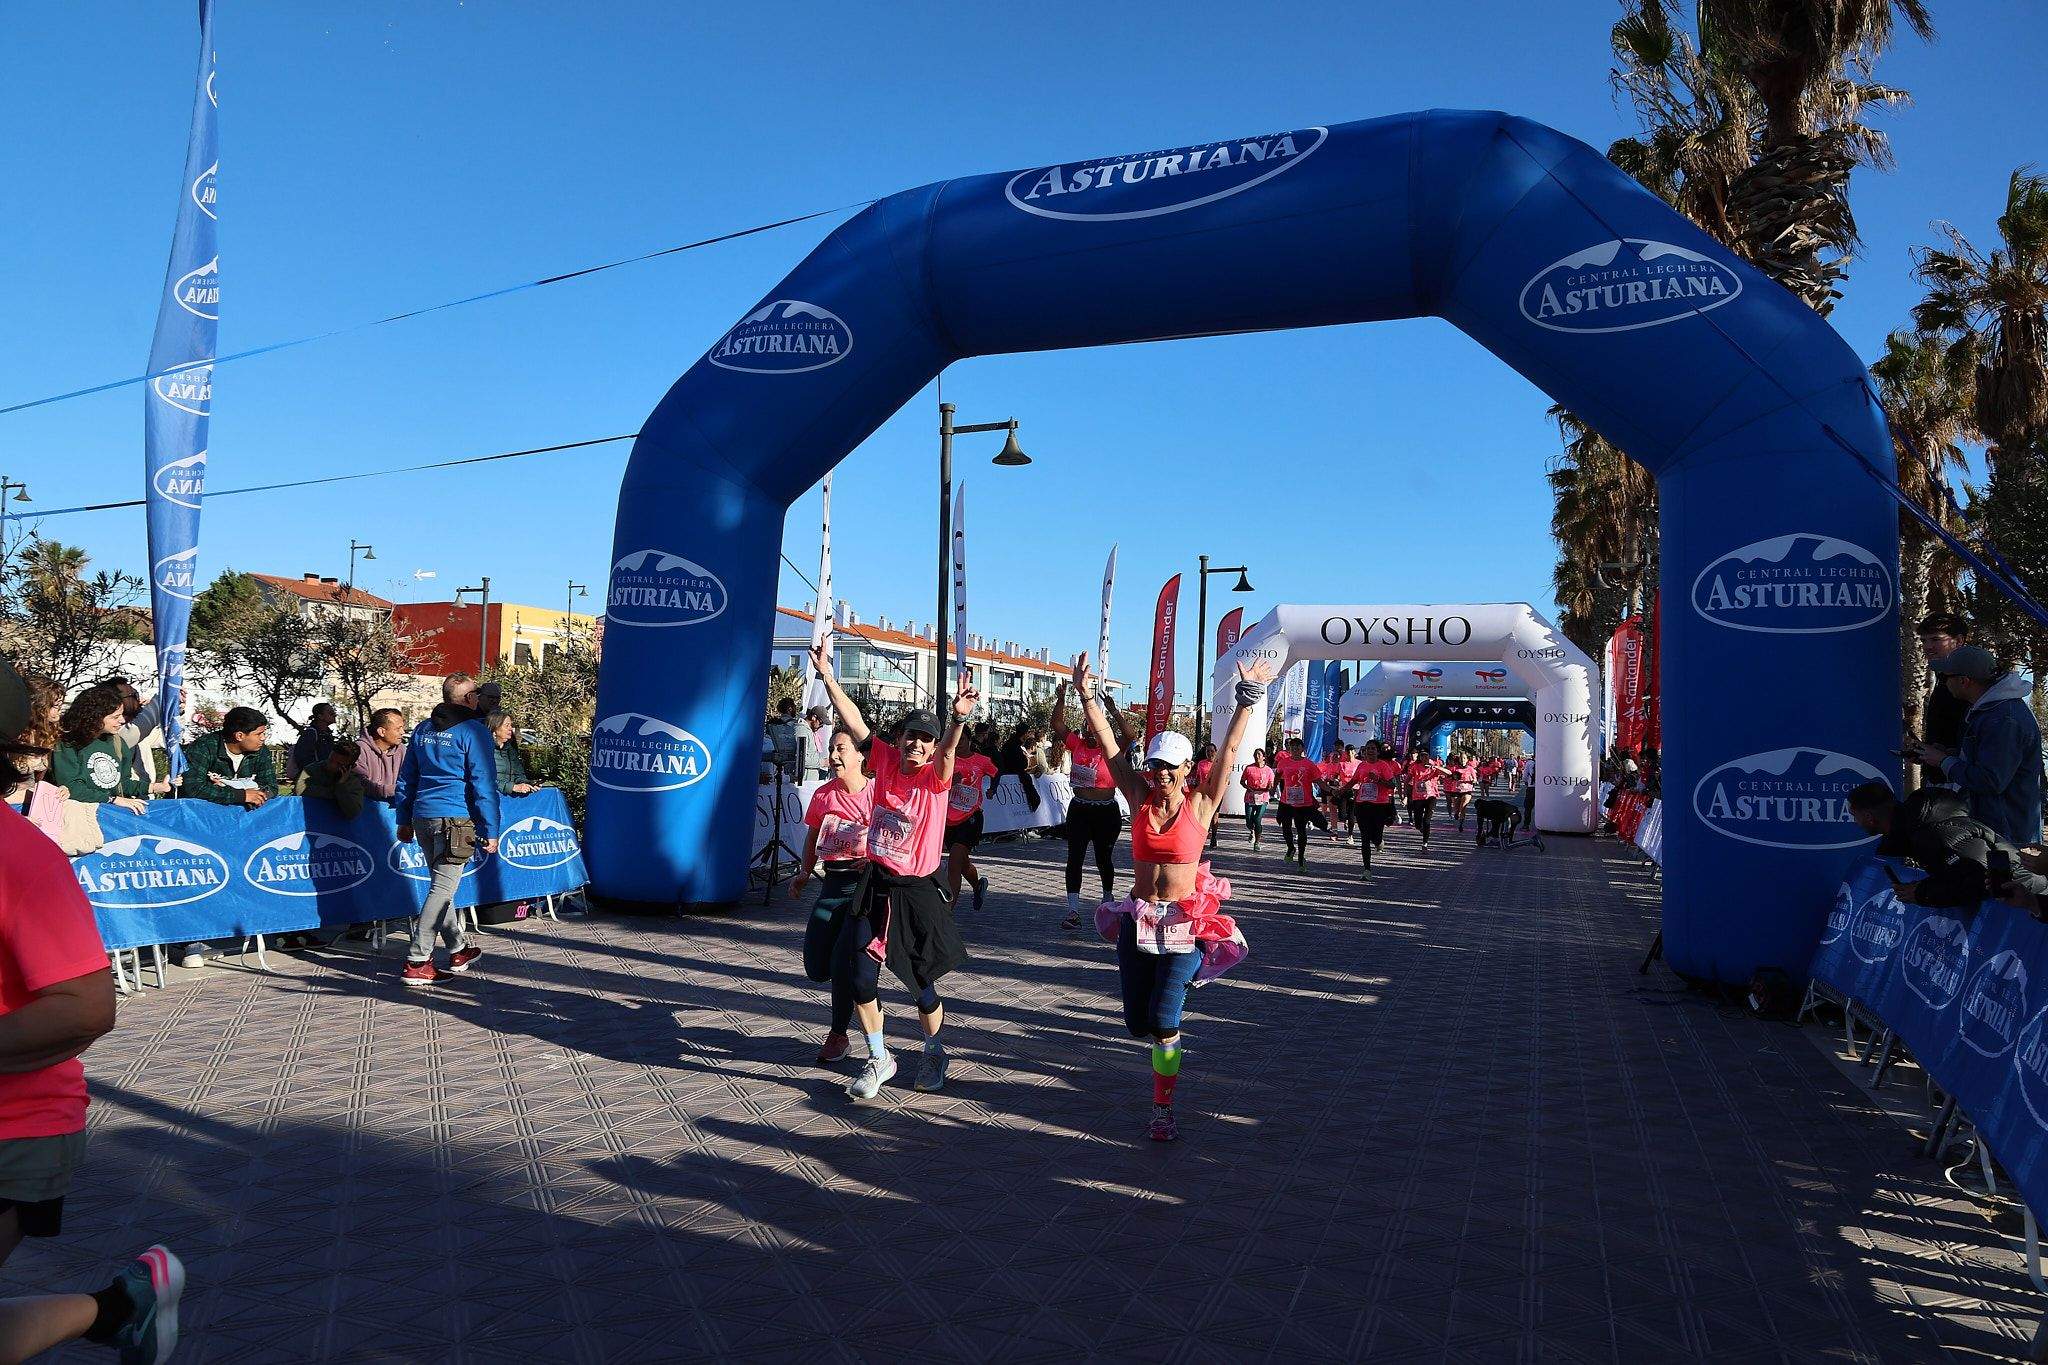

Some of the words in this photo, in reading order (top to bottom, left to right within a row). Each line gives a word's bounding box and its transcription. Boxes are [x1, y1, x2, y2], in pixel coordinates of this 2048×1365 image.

[1024, 135, 1299, 199] ASTURIANA
[1567, 269, 1639, 286] CENTRAL
[1646, 264, 1716, 275] LECHERA
[1536, 276, 1730, 319] ASTURIANA
[739, 324, 780, 336] CENTRAL
[785, 322, 835, 331] LECHERA
[713, 333, 840, 359] ASTURIANA
[617, 575, 654, 584] CENTRAL
[659, 577, 712, 589] LECHERA
[1737, 567, 1812, 580] CENTRAL
[1819, 567, 1881, 579] LECHERA
[608, 578, 714, 612] ASTURIANA
[1704, 574, 1885, 611] ASTURIANA
[1157, 600, 1173, 678] Santander
[1320, 617, 1472, 645] OYSHO
[1235, 649, 1278, 659] OYSHO
[1517, 649, 1566, 659] OYSHO
[1626, 637, 1637, 704] Santander
[1306, 679, 1324, 722] Marlene
[1449, 707, 1516, 715] VOLVO
[1154, 702, 1165, 731] orts
[1544, 713, 1590, 723] OYSHO
[600, 737, 637, 748] CENTRAL
[641, 741, 695, 753] LECHERA
[590, 738, 699, 776] ASTURIANA
[1543, 775, 1589, 786] OYSHO
[1738, 781, 1814, 792] CENTRAL
[757, 793, 803, 828] SHO
[1706, 782, 1855, 823] ASTURIA
[833, 837, 851, 849] 016
[882, 829, 901, 841] 016
[275, 853, 315, 862] CENTRAL
[506, 838, 579, 858] ASTURIANA
[100, 860, 157, 870] CENTRAL
[161, 858, 212, 867] LECHERA
[256, 857, 368, 883] ASTURIANA
[78, 864, 221, 894] ASTURIANA
